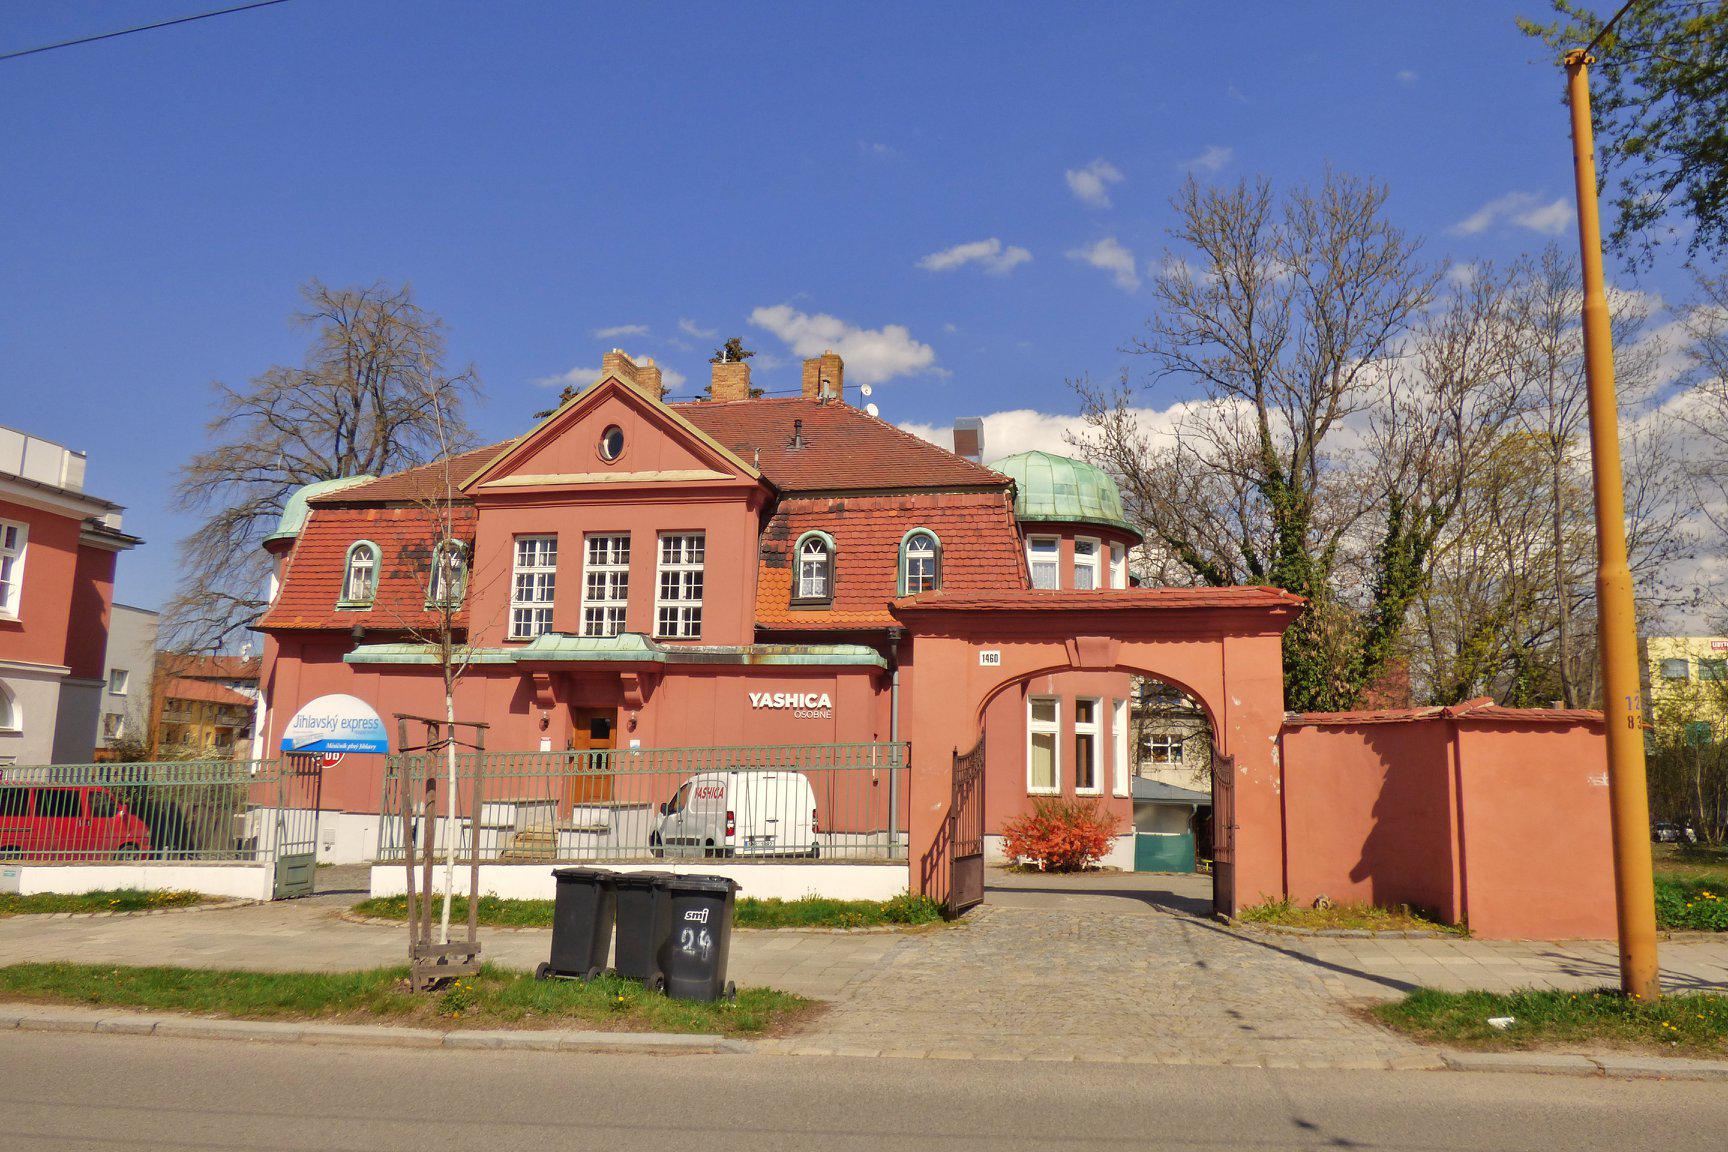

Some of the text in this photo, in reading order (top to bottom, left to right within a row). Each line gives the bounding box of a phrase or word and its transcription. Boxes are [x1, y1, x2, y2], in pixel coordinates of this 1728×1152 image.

[982, 653, 999, 663] 1460
[748, 691, 833, 710] YASHICA
[293, 714, 379, 732] Jihlavský express
[694, 786, 725, 799] YASHICA
[684, 908, 709, 924] smj
